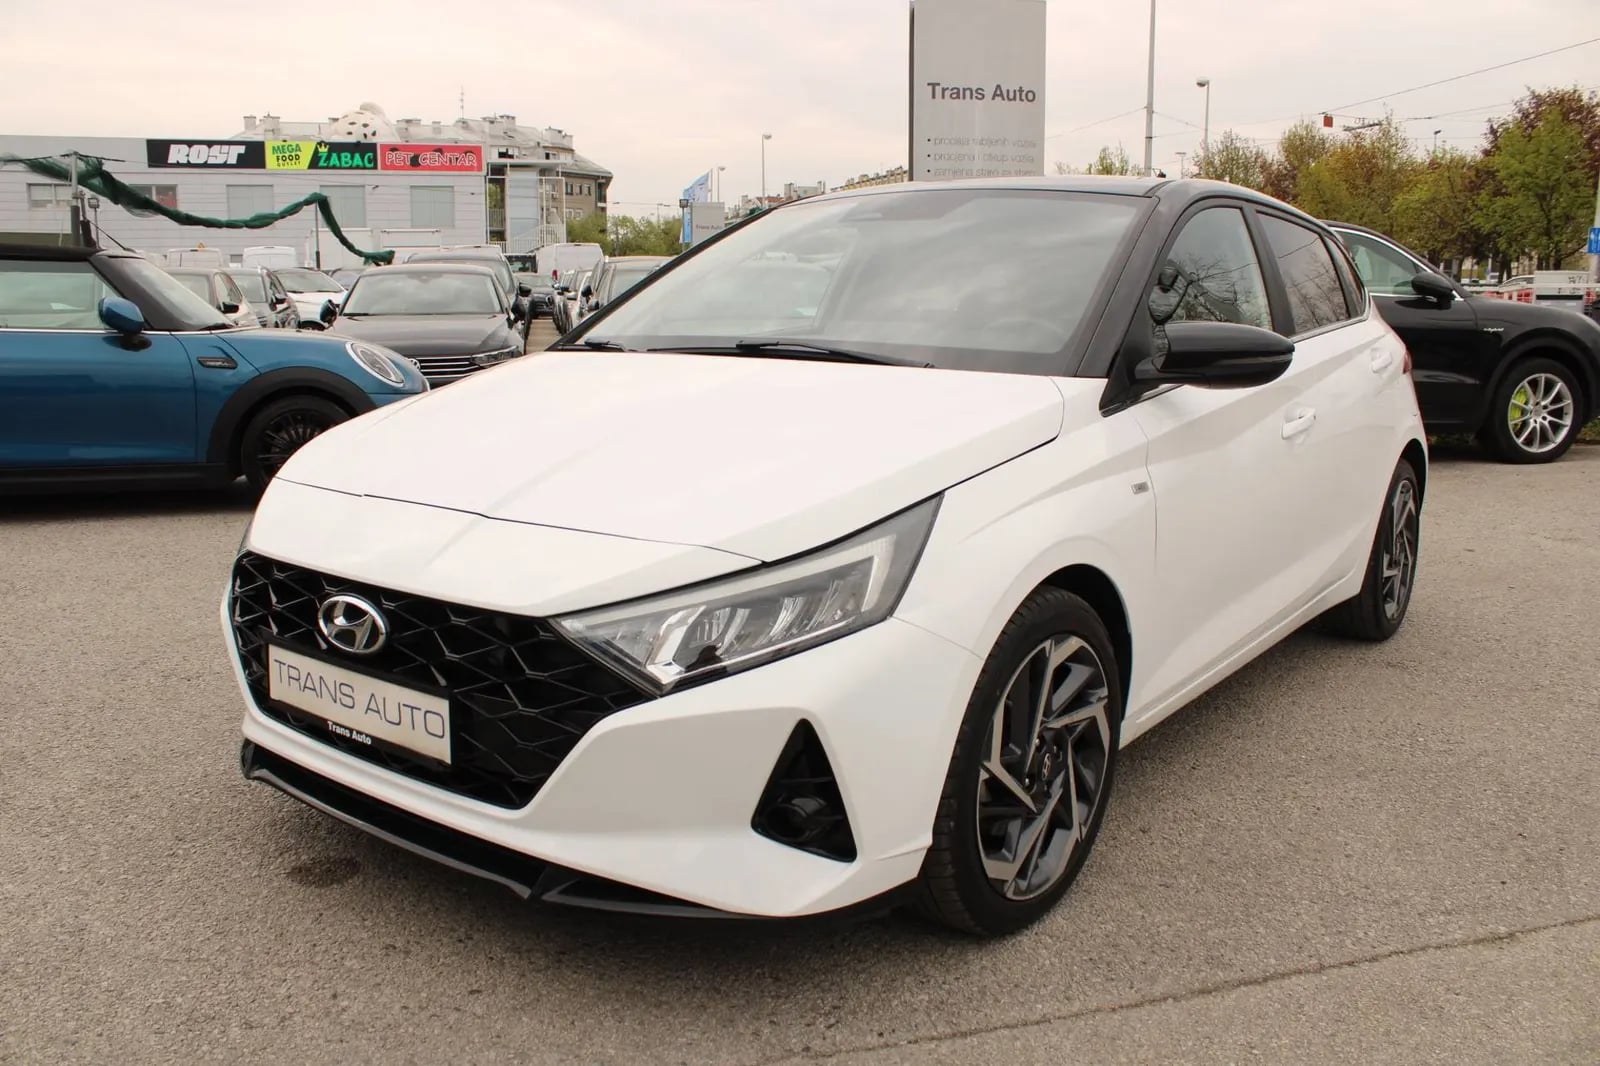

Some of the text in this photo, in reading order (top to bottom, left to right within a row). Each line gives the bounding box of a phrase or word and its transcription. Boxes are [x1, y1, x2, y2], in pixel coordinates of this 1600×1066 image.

[927, 82, 1036, 102] Trans Auto
[167, 144, 246, 165] ROST
[272, 143, 302, 155] MEGA
[276, 153, 300, 162] FOOD
[385, 151, 477, 167] PET CENTAR
[274, 658, 445, 739] TRANS AUTO
[327, 720, 372, 745] Trans Auto
